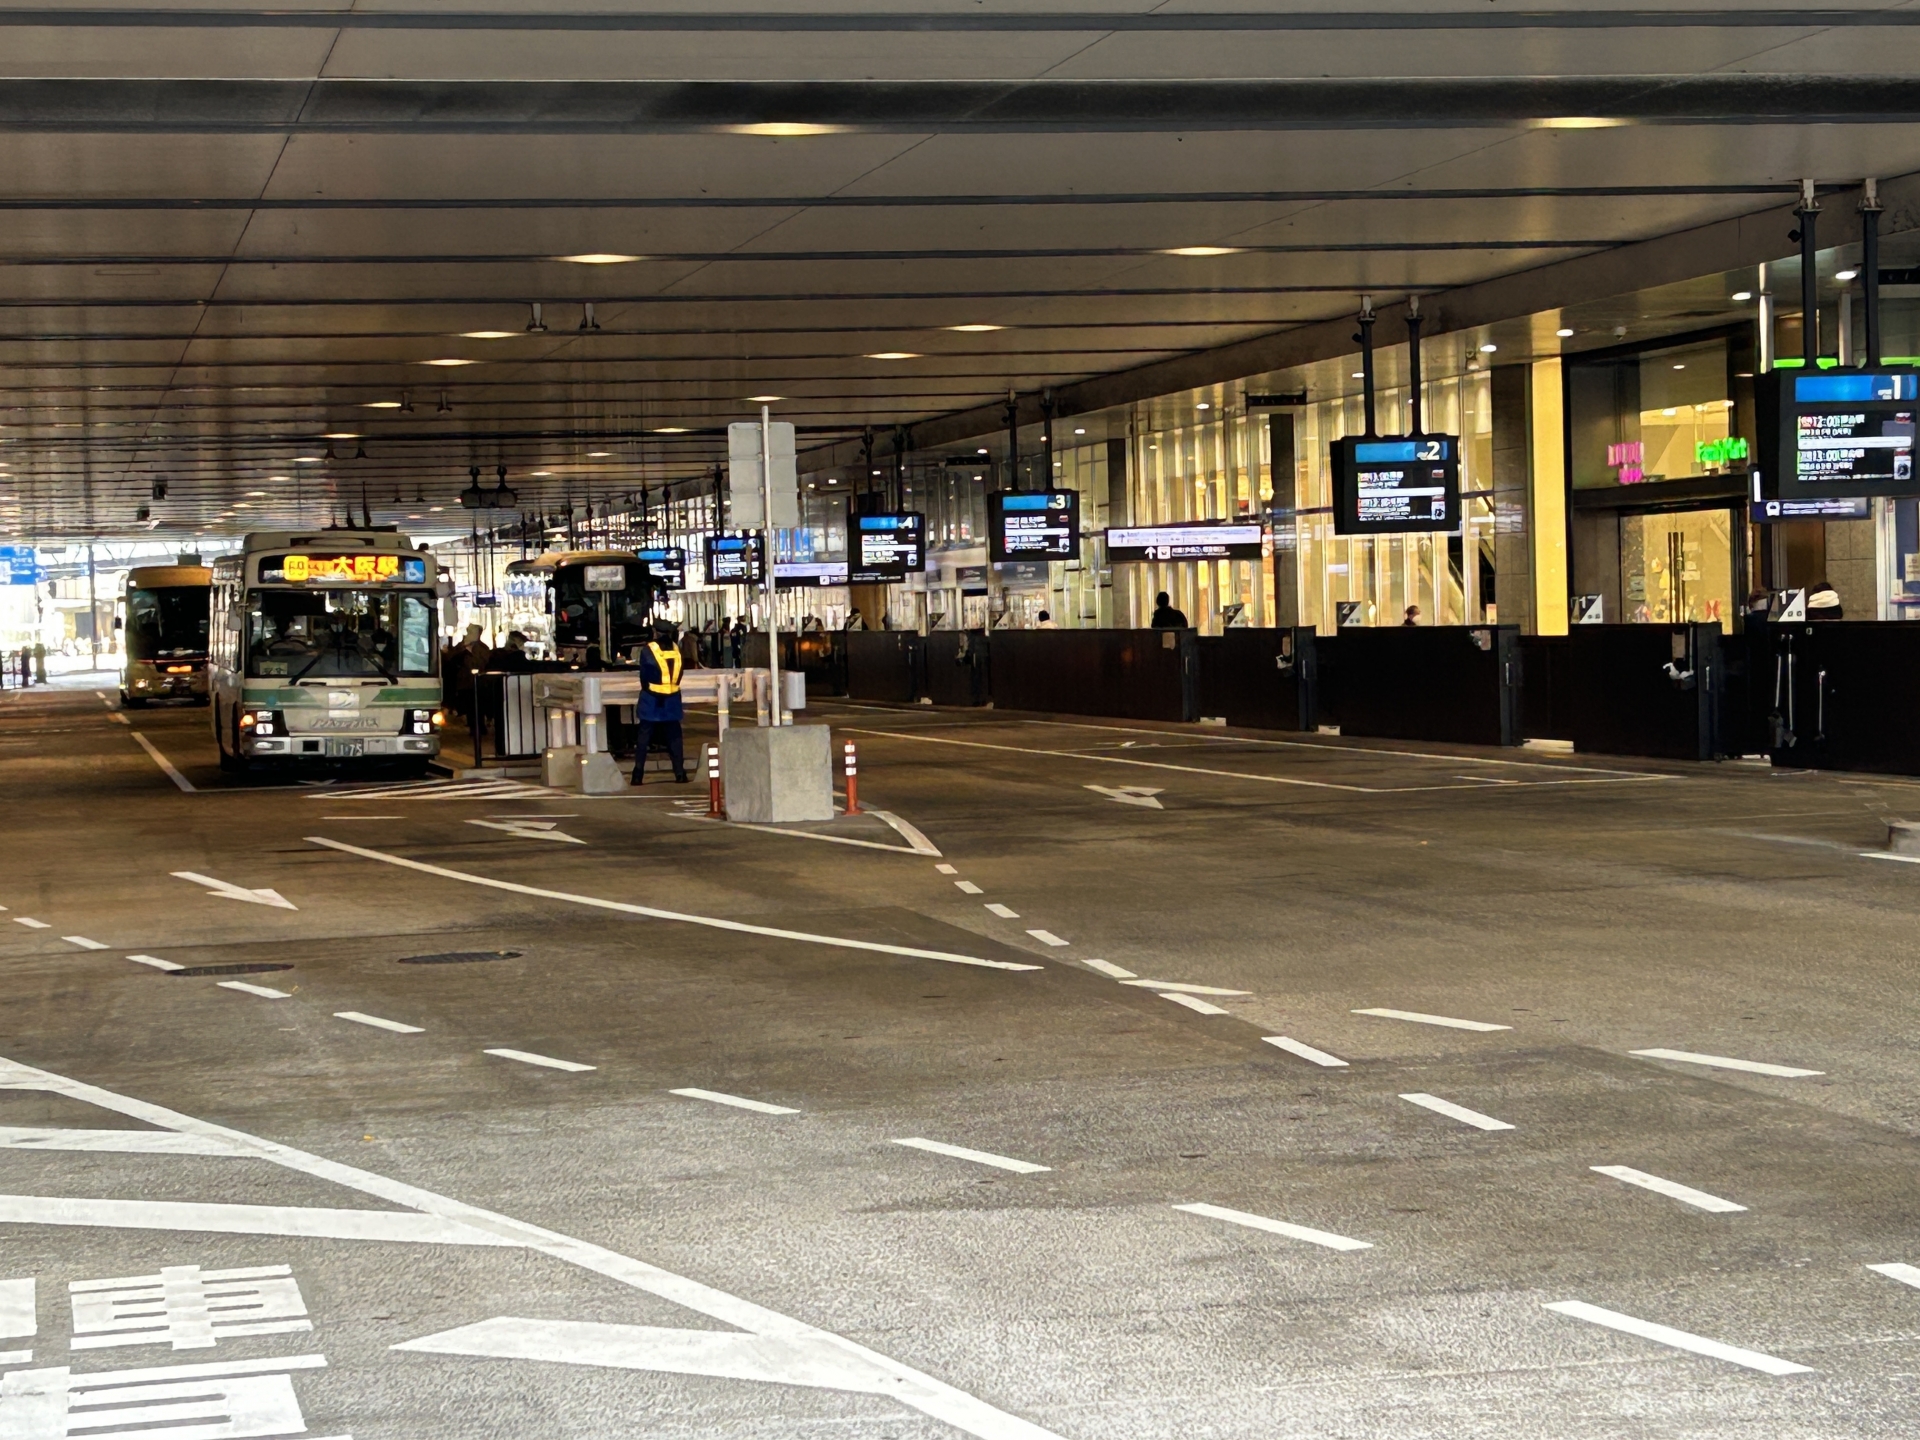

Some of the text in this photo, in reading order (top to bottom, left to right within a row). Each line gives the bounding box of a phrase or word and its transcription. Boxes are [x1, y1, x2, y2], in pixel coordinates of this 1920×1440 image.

[1891, 374, 1901, 400] 1
[1426, 441, 1440, 460] 2
[1055, 494, 1065, 509] 3
[333, 556, 399, 576] 大阪駅
[1779, 590, 1787, 605] 1
